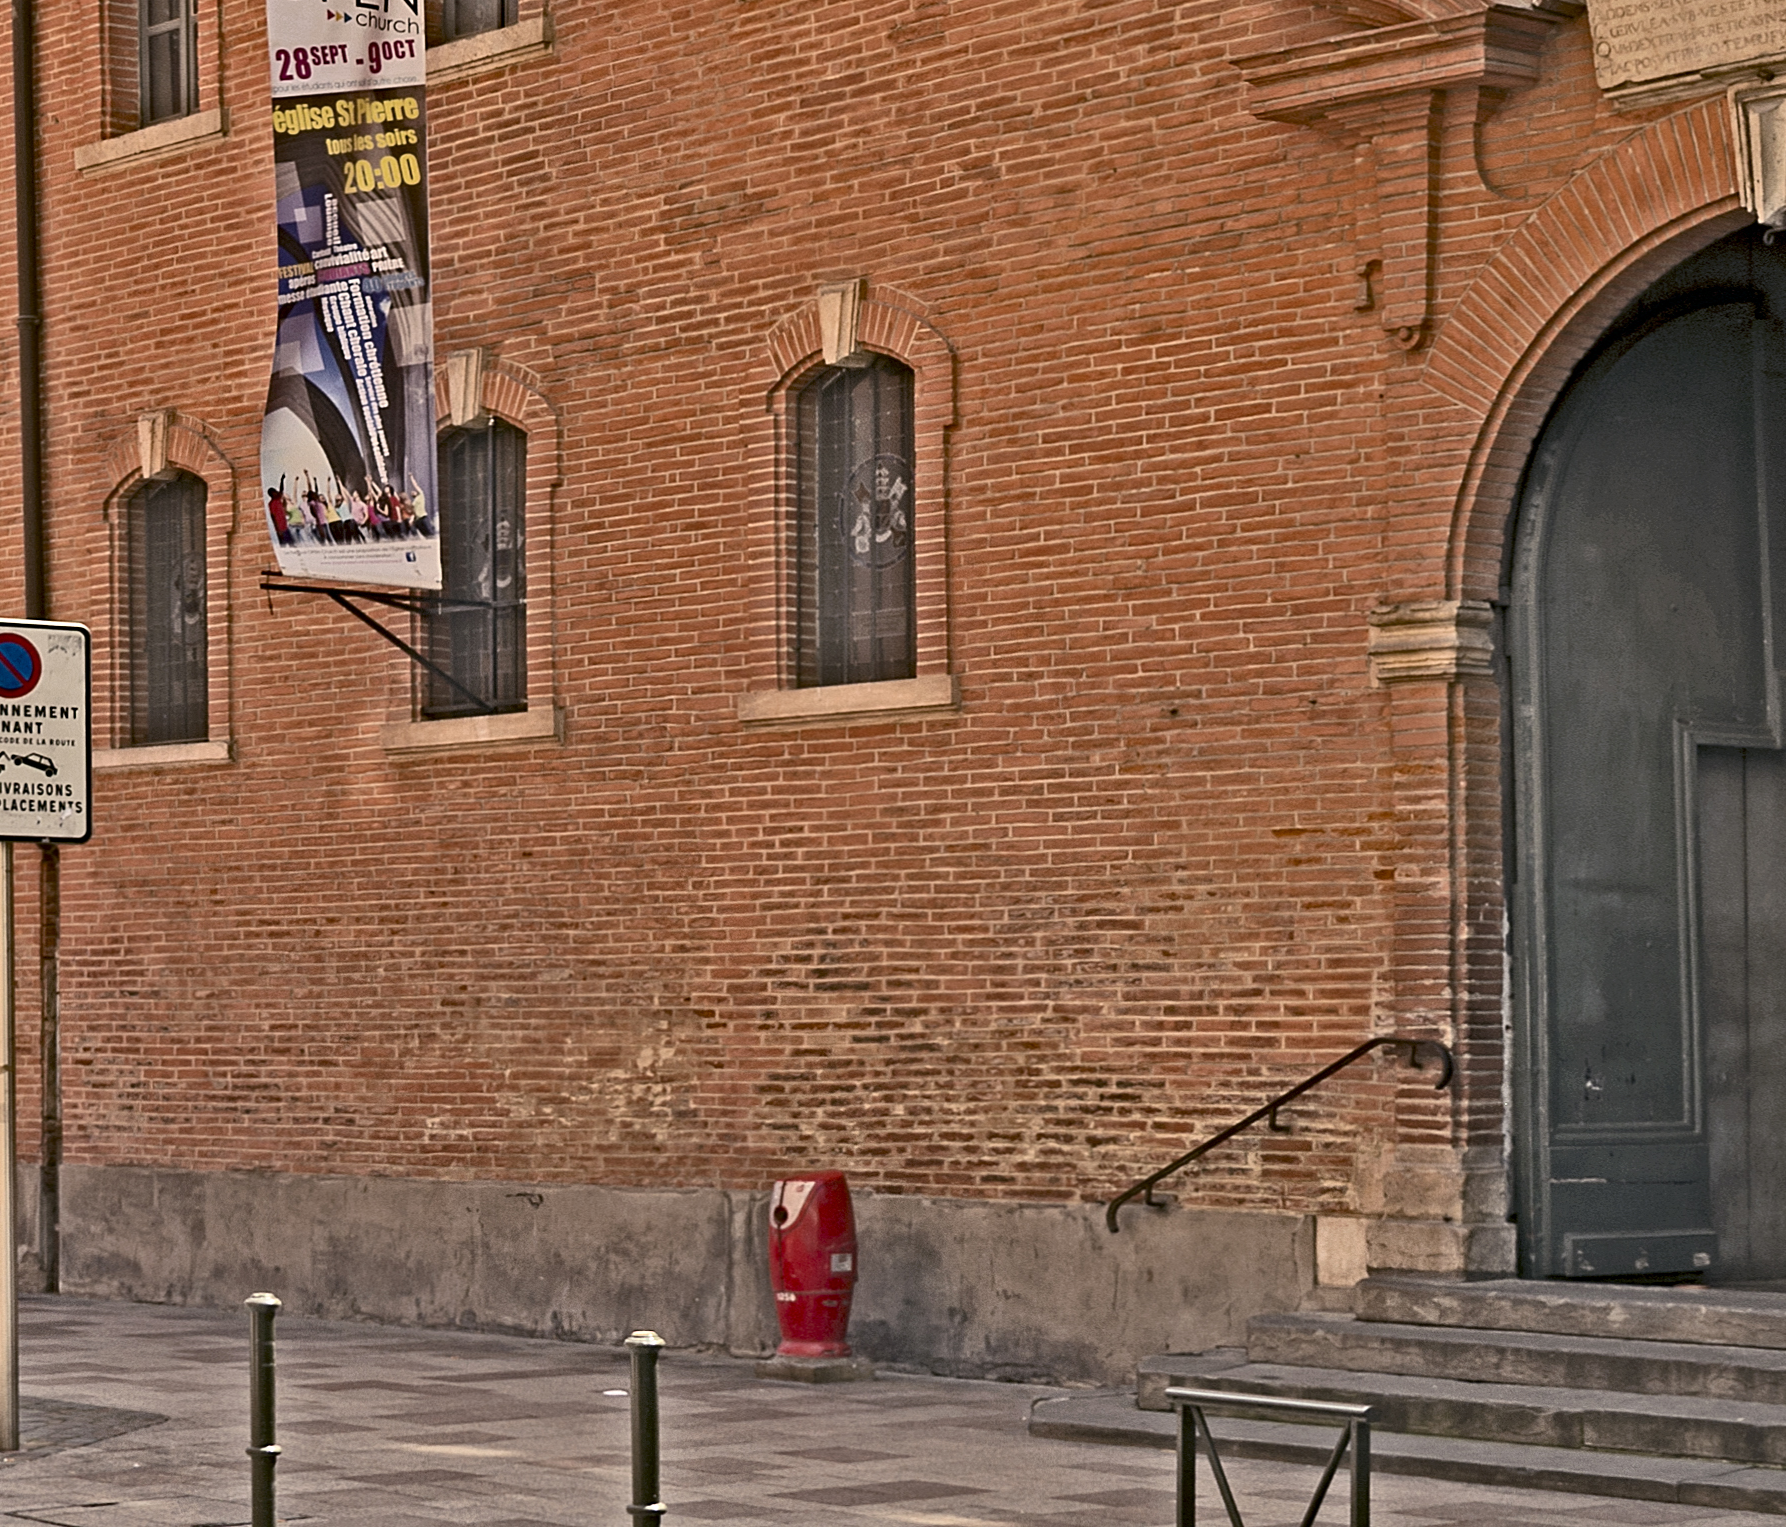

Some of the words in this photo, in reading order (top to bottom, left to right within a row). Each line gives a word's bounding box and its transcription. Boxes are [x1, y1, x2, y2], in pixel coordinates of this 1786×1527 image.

[355, 11, 420, 35] church
[273, 102, 334, 135] église
[335, 99, 356, 127] St
[357, 96, 420, 125] Pierre
[326, 136, 353, 156] tous
[353, 134, 374, 152] les
[375, 128, 418, 149] soirs
[344, 153, 421, 195] 20:00
[337, 292, 354, 329] Chant
[347, 329, 367, 377] chorale
[348, 278, 373, 340] Formation
[363, 341, 390, 408] chrétienne
[23, 737, 34, 746] DE
[36, 738, 47, 746] LA
[49, 738, 76, 747] ROUTE
